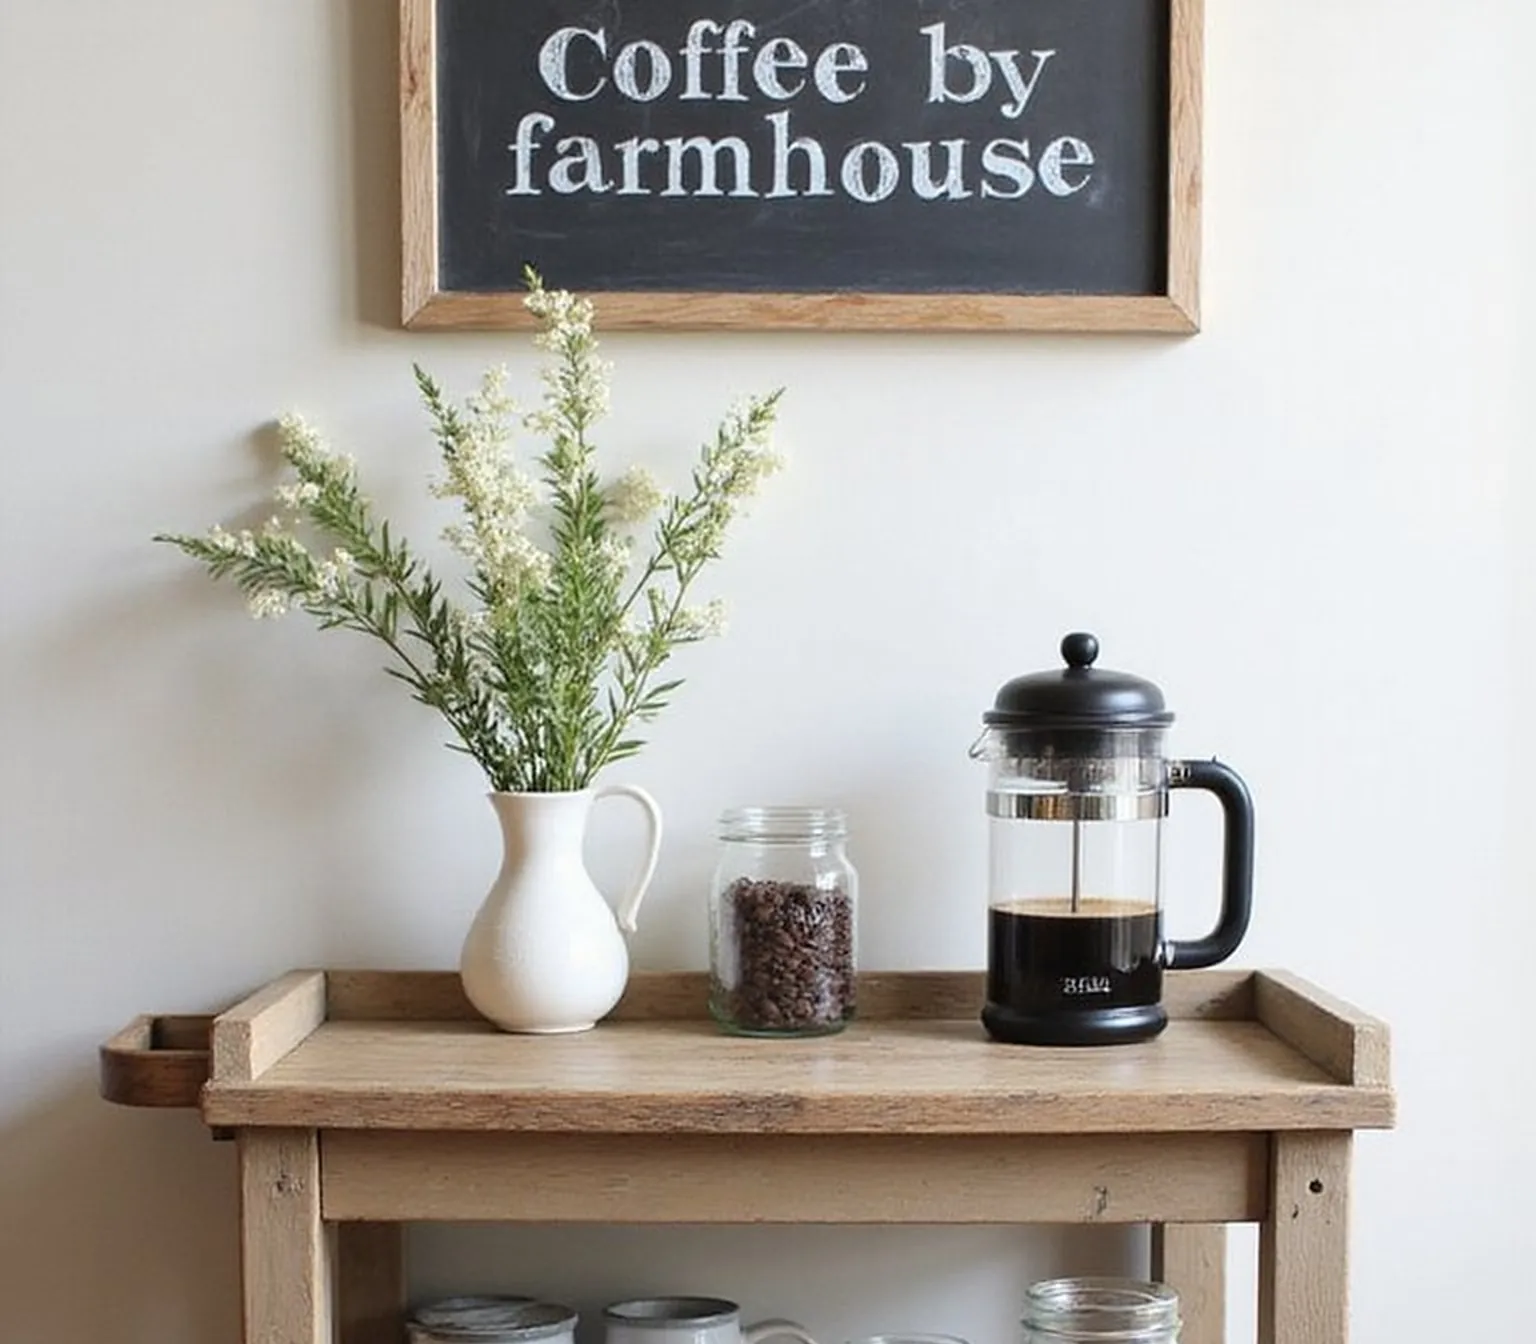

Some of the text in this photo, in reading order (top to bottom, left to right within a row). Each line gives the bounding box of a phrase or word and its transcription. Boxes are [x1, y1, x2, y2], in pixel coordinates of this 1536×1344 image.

[539, 19, 1056, 119] Coffee by
[506, 109, 1096, 201] farmhouse
